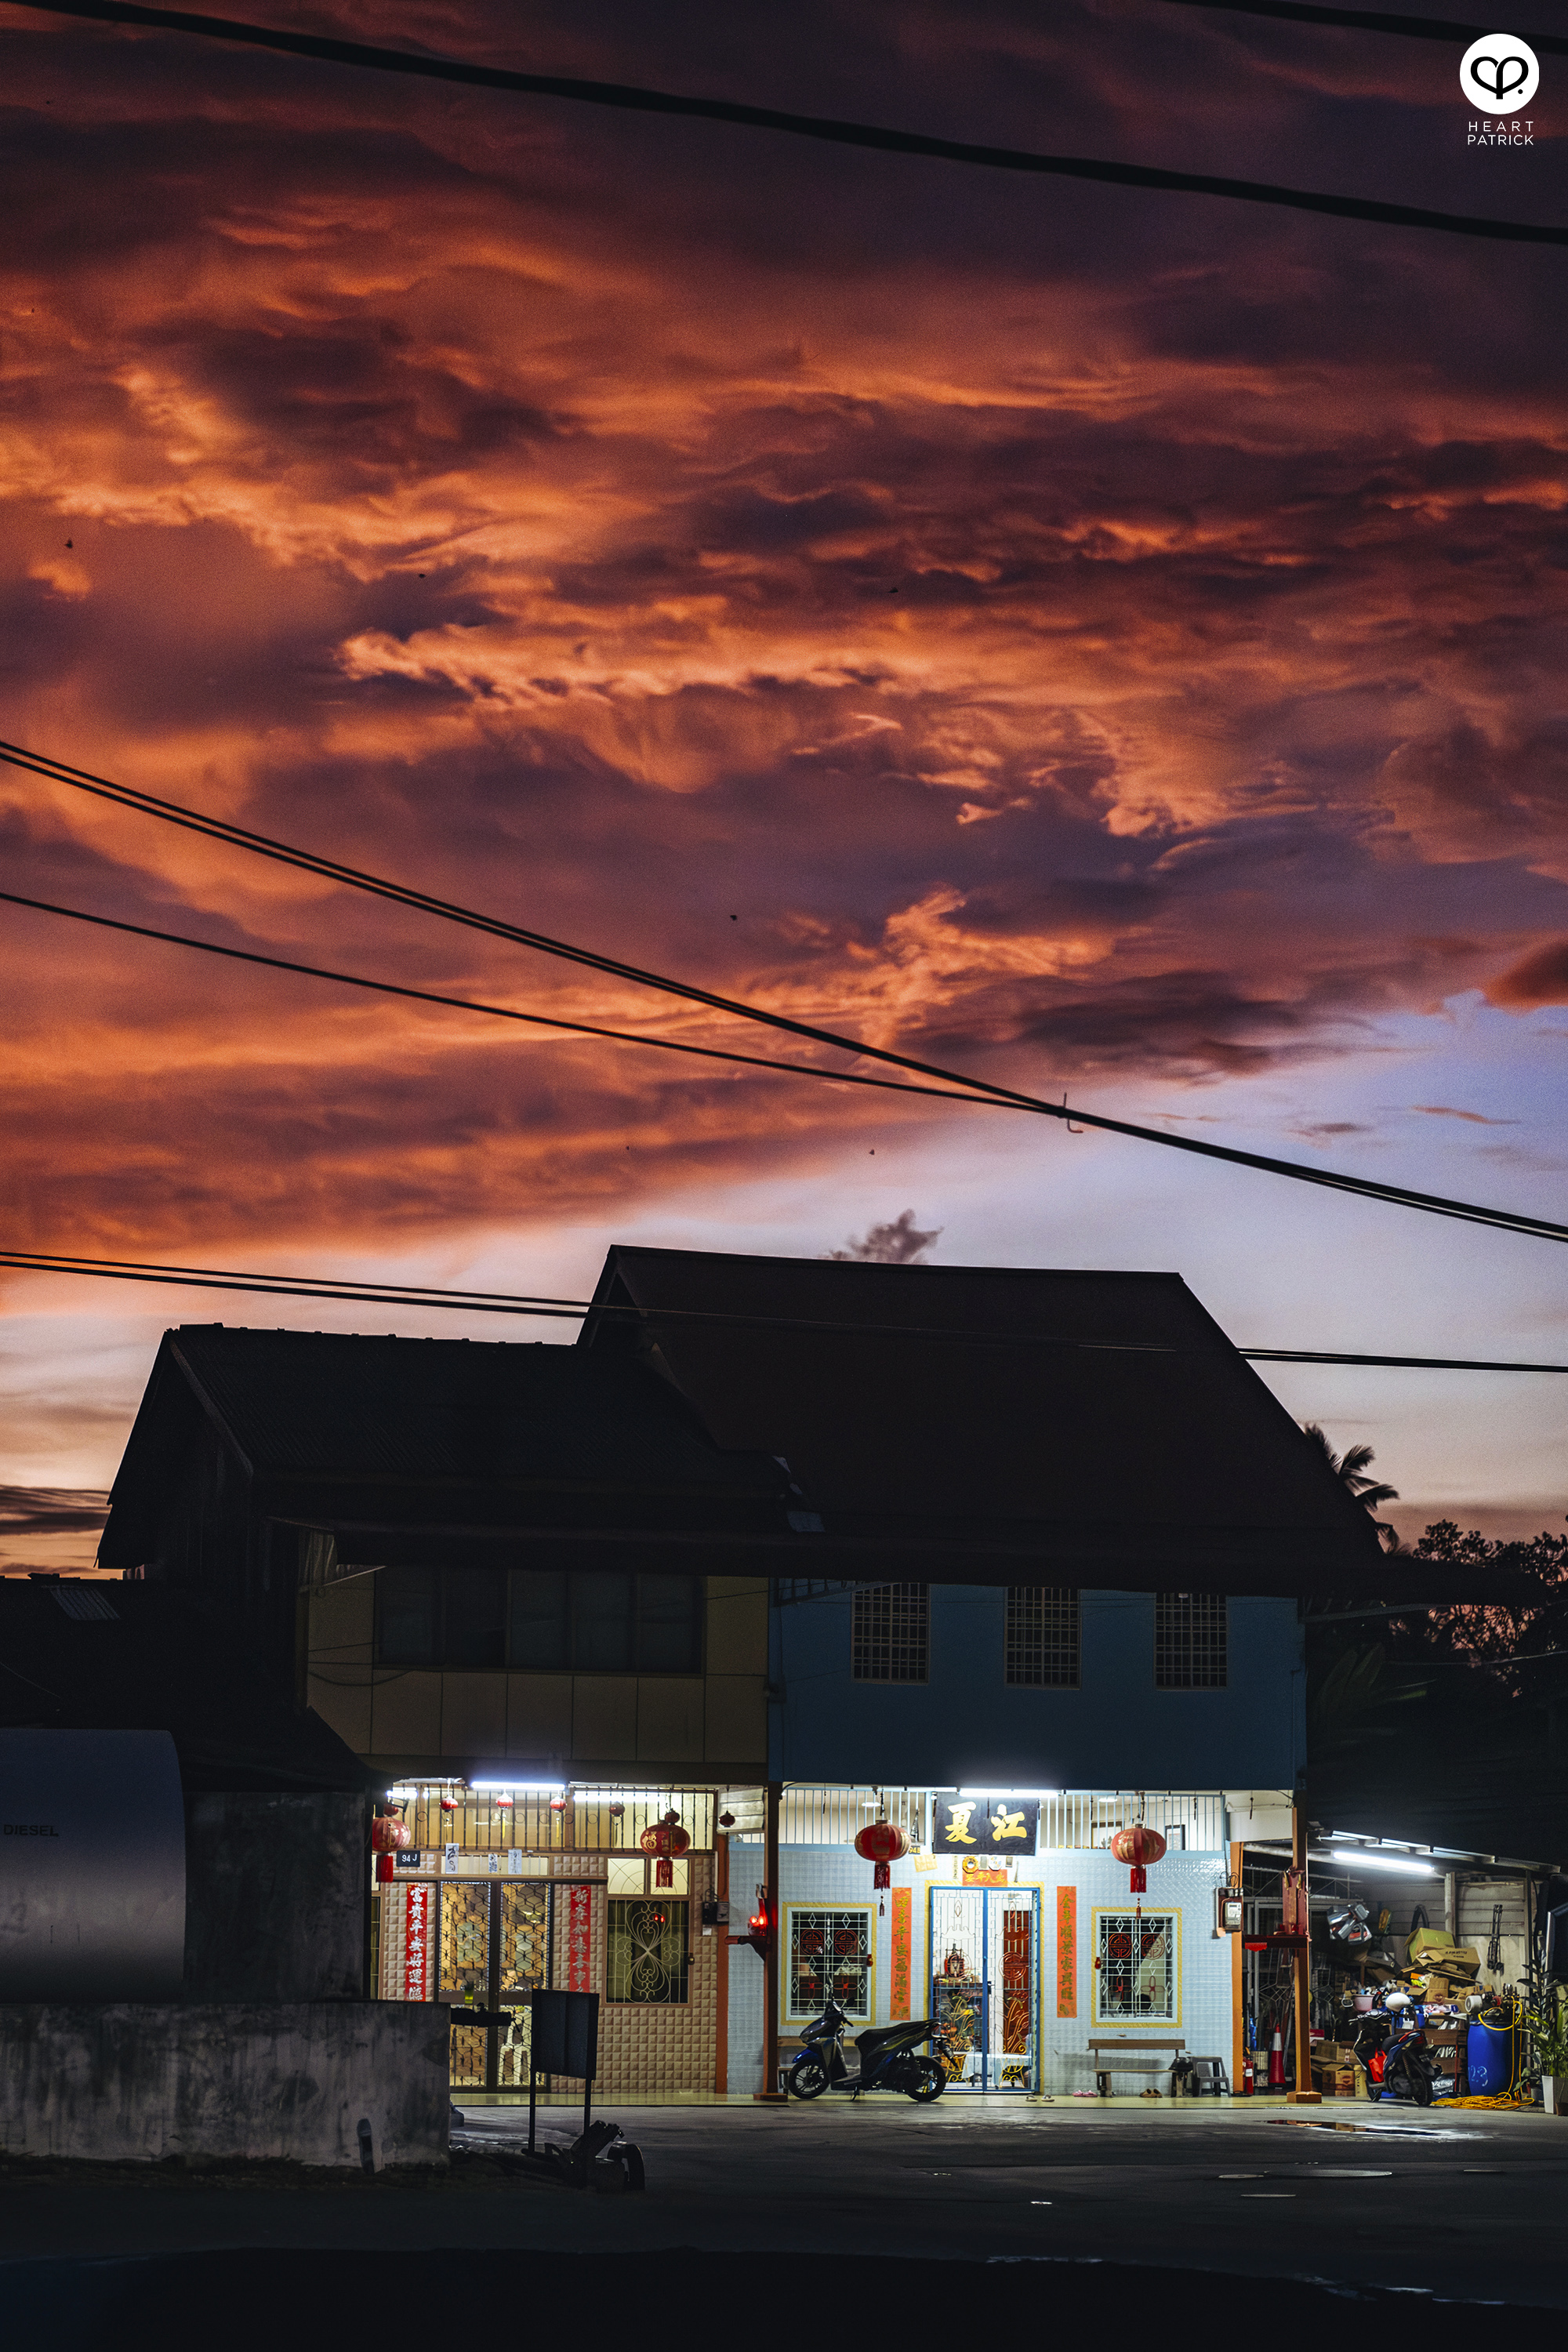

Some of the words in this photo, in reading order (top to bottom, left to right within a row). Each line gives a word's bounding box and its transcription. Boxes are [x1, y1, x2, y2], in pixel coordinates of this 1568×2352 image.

[3, 1824, 60, 1837] DIESEL
[572, 1889, 589, 1992] 新春如意喜事
